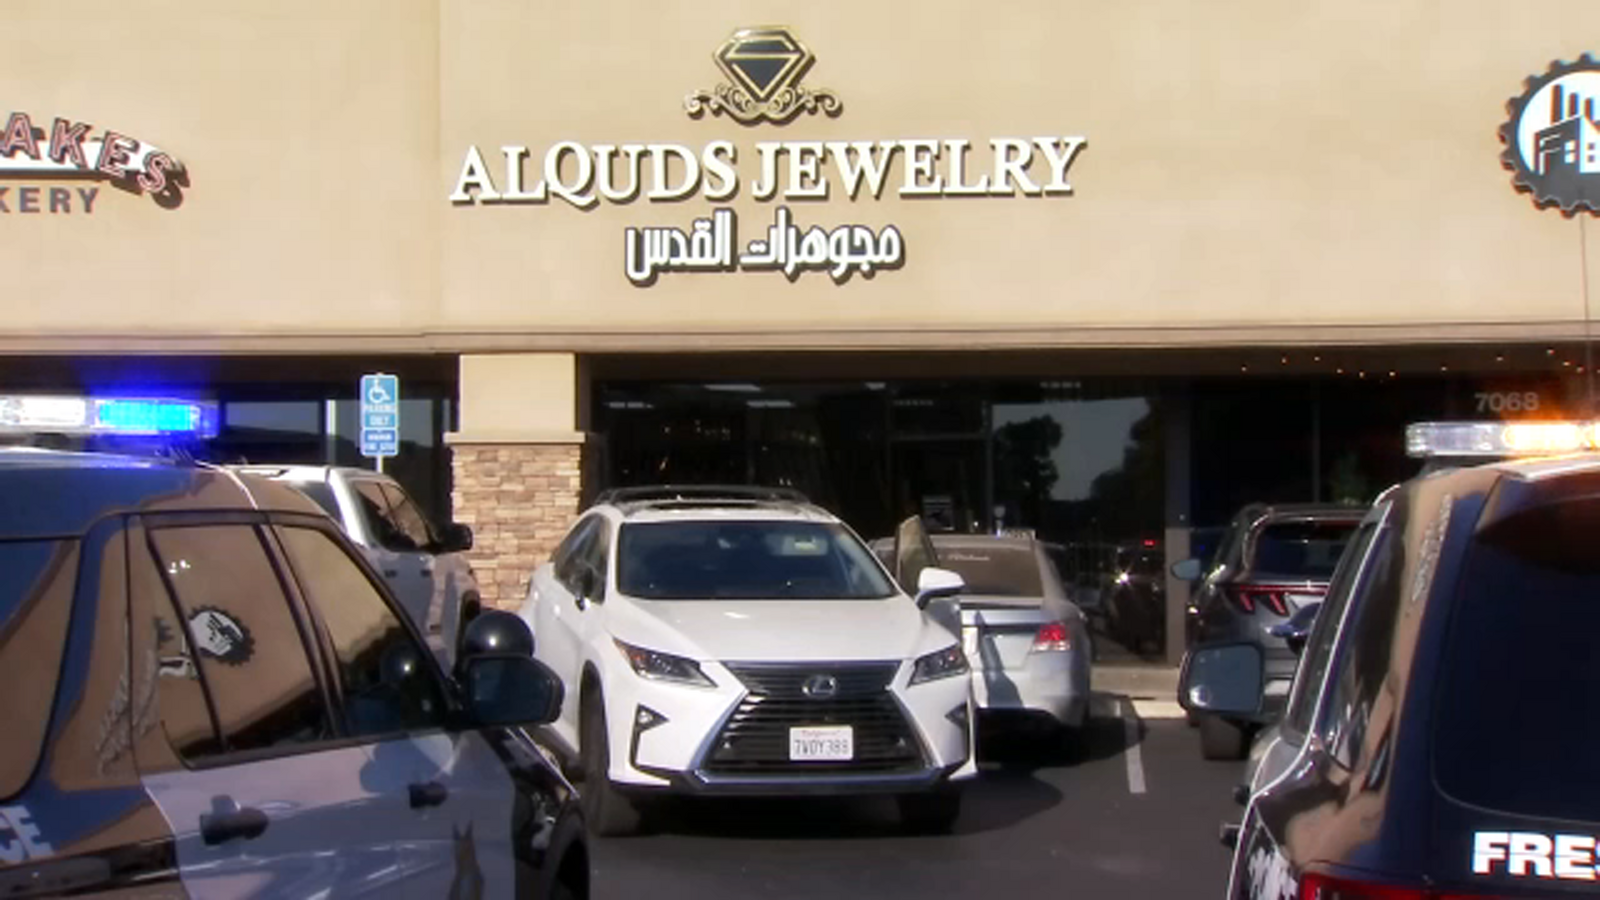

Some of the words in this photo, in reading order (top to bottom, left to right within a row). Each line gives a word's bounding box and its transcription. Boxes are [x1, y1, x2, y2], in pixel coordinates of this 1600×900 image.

[450, 141, 739, 208] ALQUDS
[752, 137, 1086, 198] JEWELRY
[625, 208, 735, 283] القدس
[739, 206, 904, 281] مجوهرات
[1474, 391, 1540, 413] 7068
[1473, 832, 1600, 880] FRE
